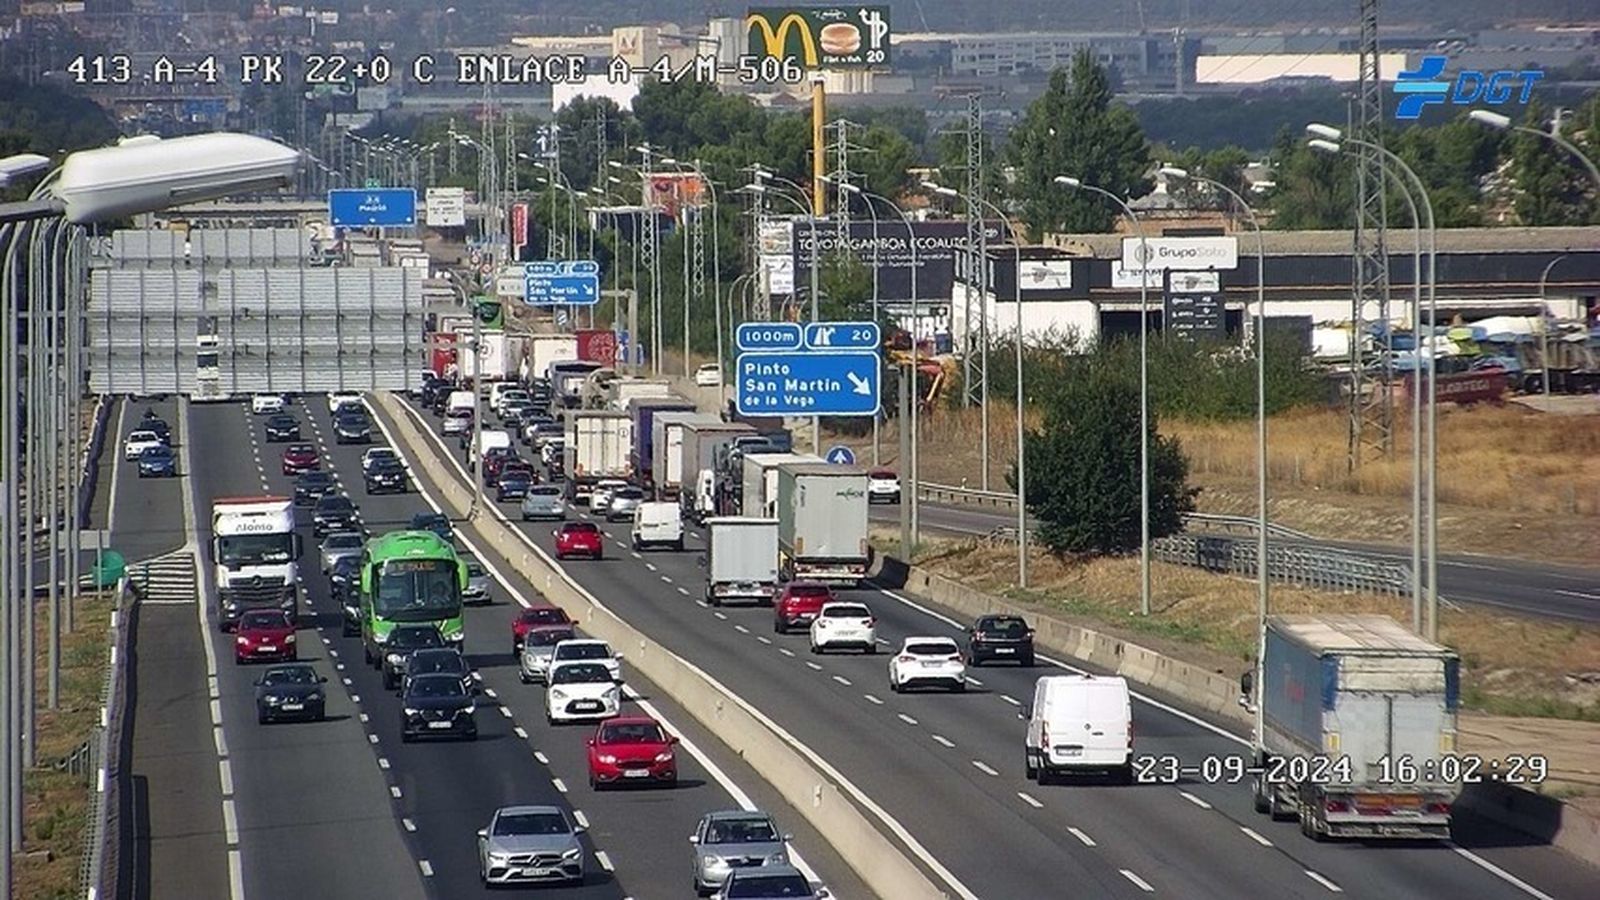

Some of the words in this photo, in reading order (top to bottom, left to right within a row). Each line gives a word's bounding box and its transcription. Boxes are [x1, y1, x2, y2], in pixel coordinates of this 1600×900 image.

[866, 50, 886, 63] 20
[799, 237, 849, 251] TOYOTA
[745, 331, 795, 343] 1000m
[851, 329, 872, 341] 20
[744, 363, 791, 376] Pinto
[745, 379, 777, 392] San
[744, 395, 760, 406] de
[765, 395, 778, 406] la
[783, 395, 815, 408] Vega
